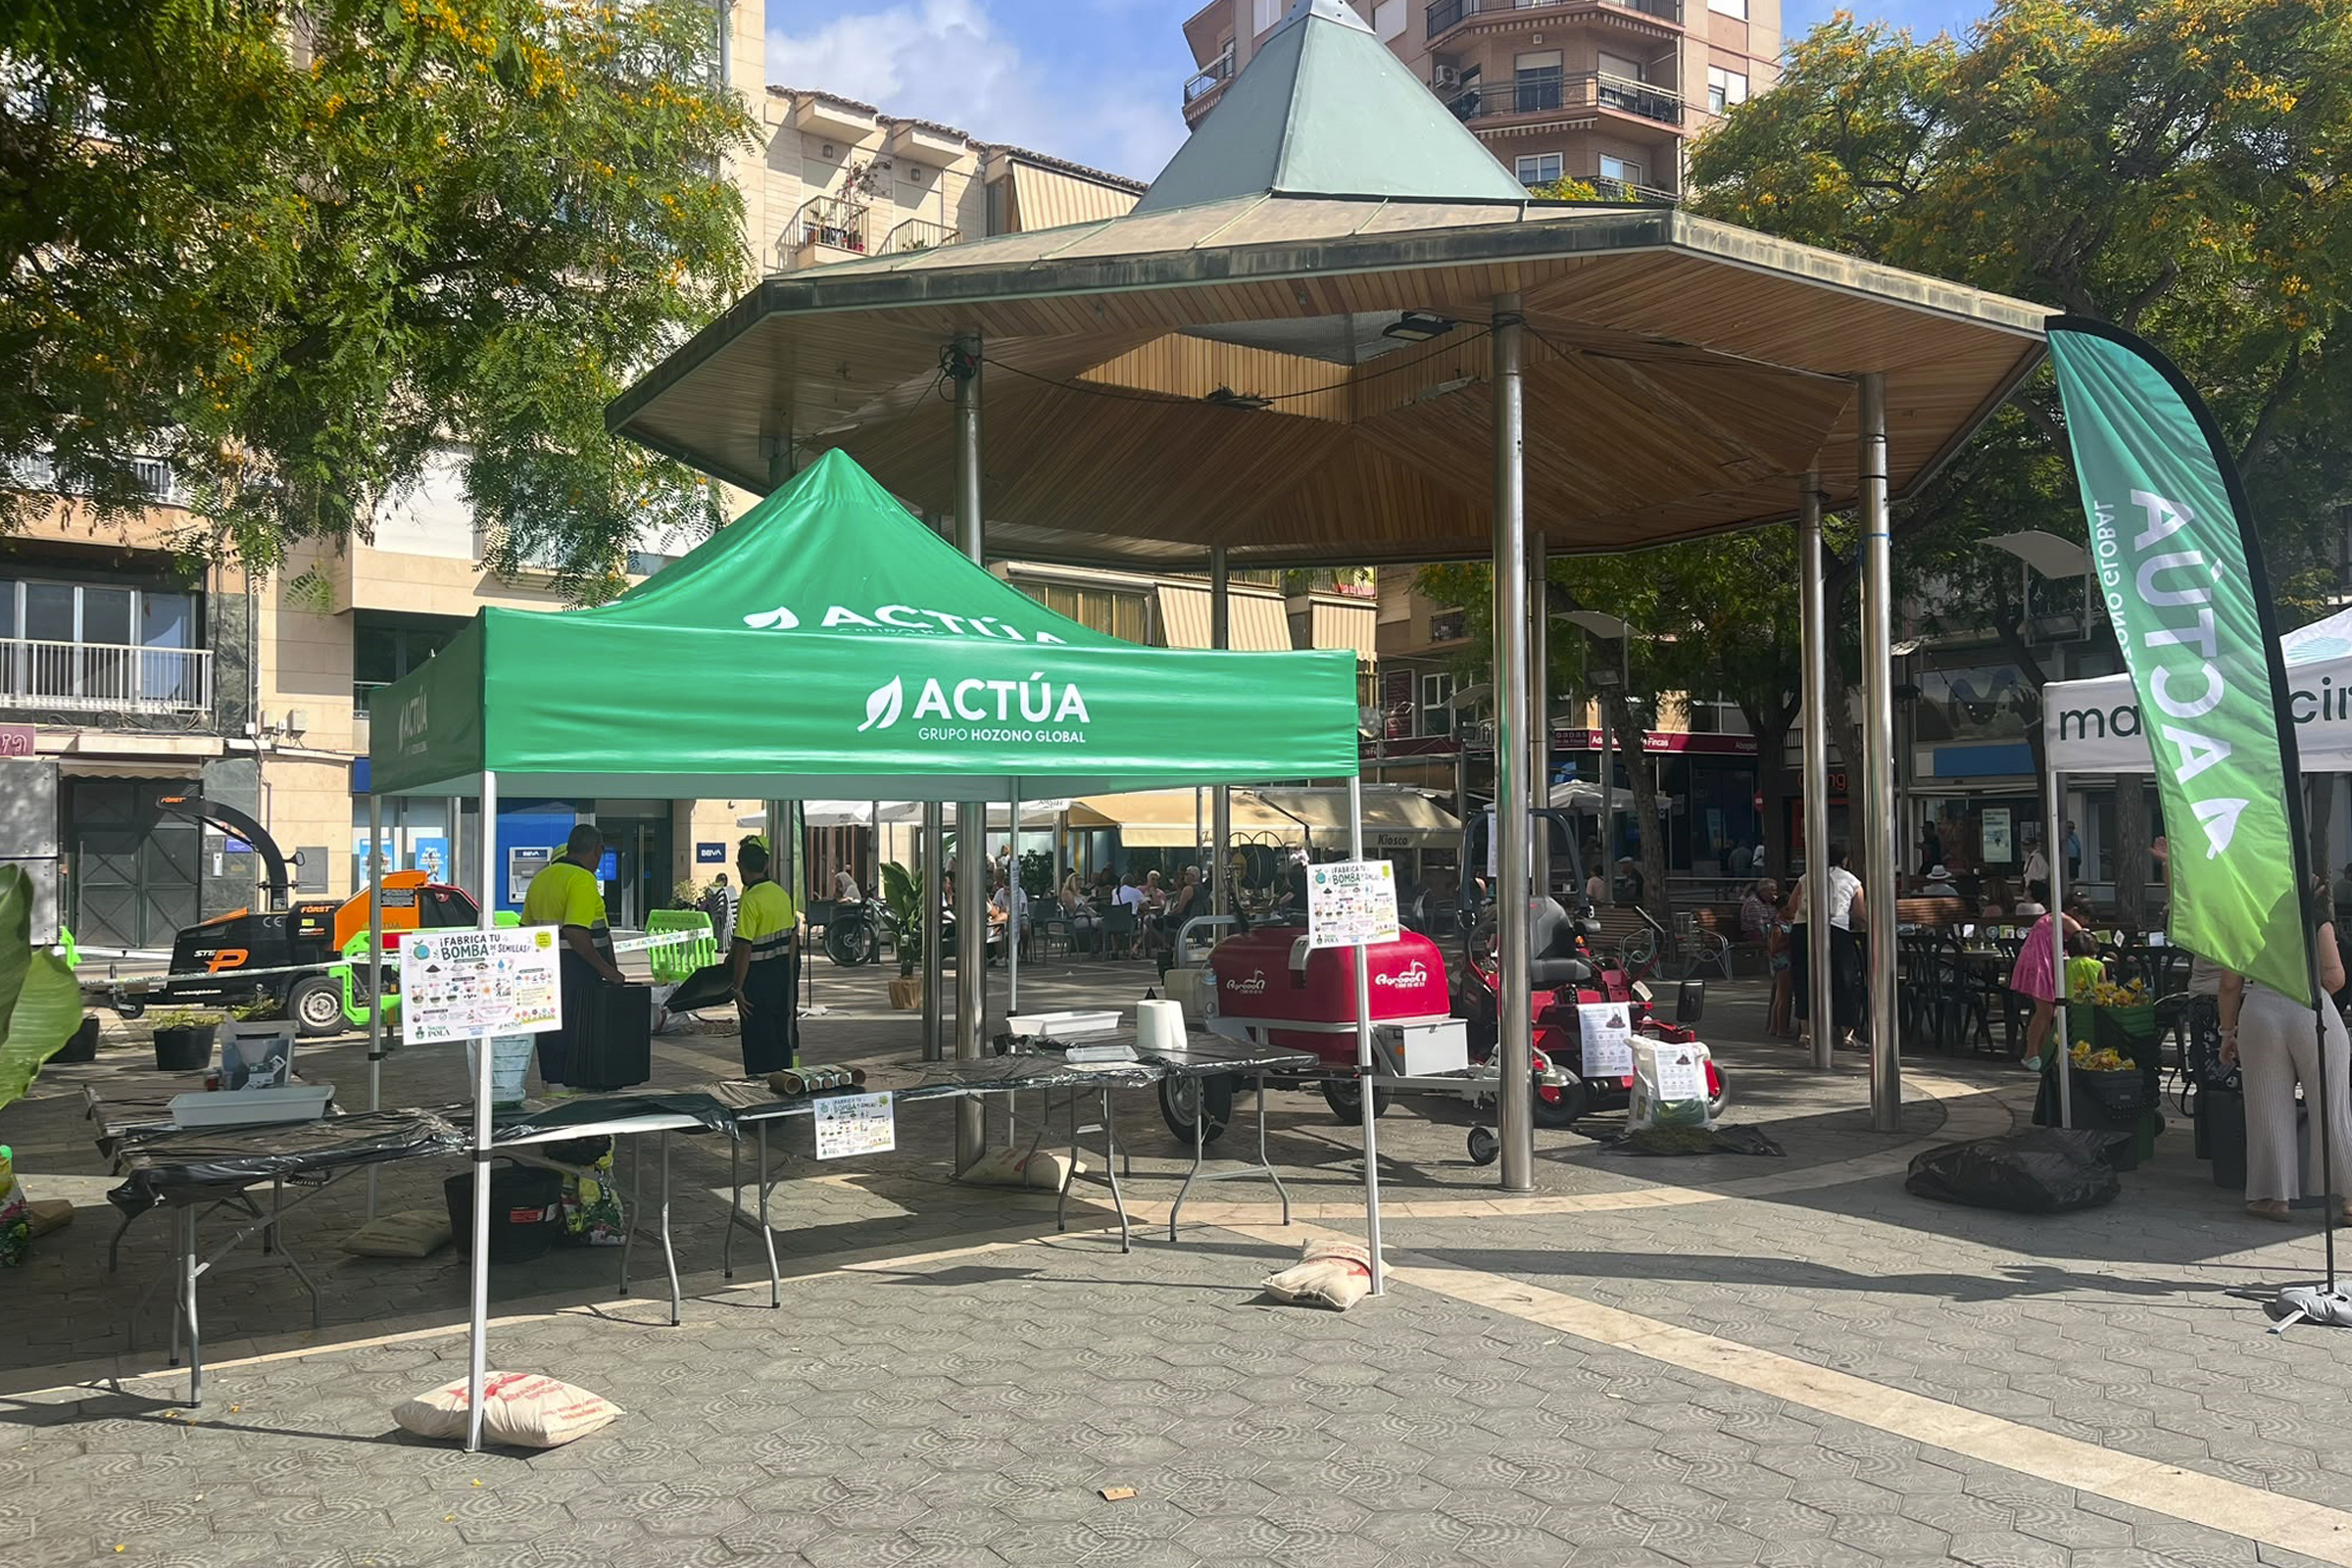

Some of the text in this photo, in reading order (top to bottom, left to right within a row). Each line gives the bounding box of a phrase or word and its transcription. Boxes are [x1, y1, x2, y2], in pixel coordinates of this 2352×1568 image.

[911, 671, 1091, 723] ACTÚA
[402, 685, 428, 738] ACTÚA
[918, 728, 1086, 743] GRUPO HOZONO GLOBAL
[1647, 737, 1669, 747] Fincas
[1735, 741, 1757, 751] Abogad
[1377, 833, 1408, 846] Kiosco
[701, 849, 721, 858] BBVA
[1333, 873, 1360, 885] BOMBA
[300, 905, 334, 913] FÖRST
[439, 934, 501, 948] ¡FABRICA TU
[441, 944, 489, 960] BOMBA
[427, 1029, 451, 1038] POLA
